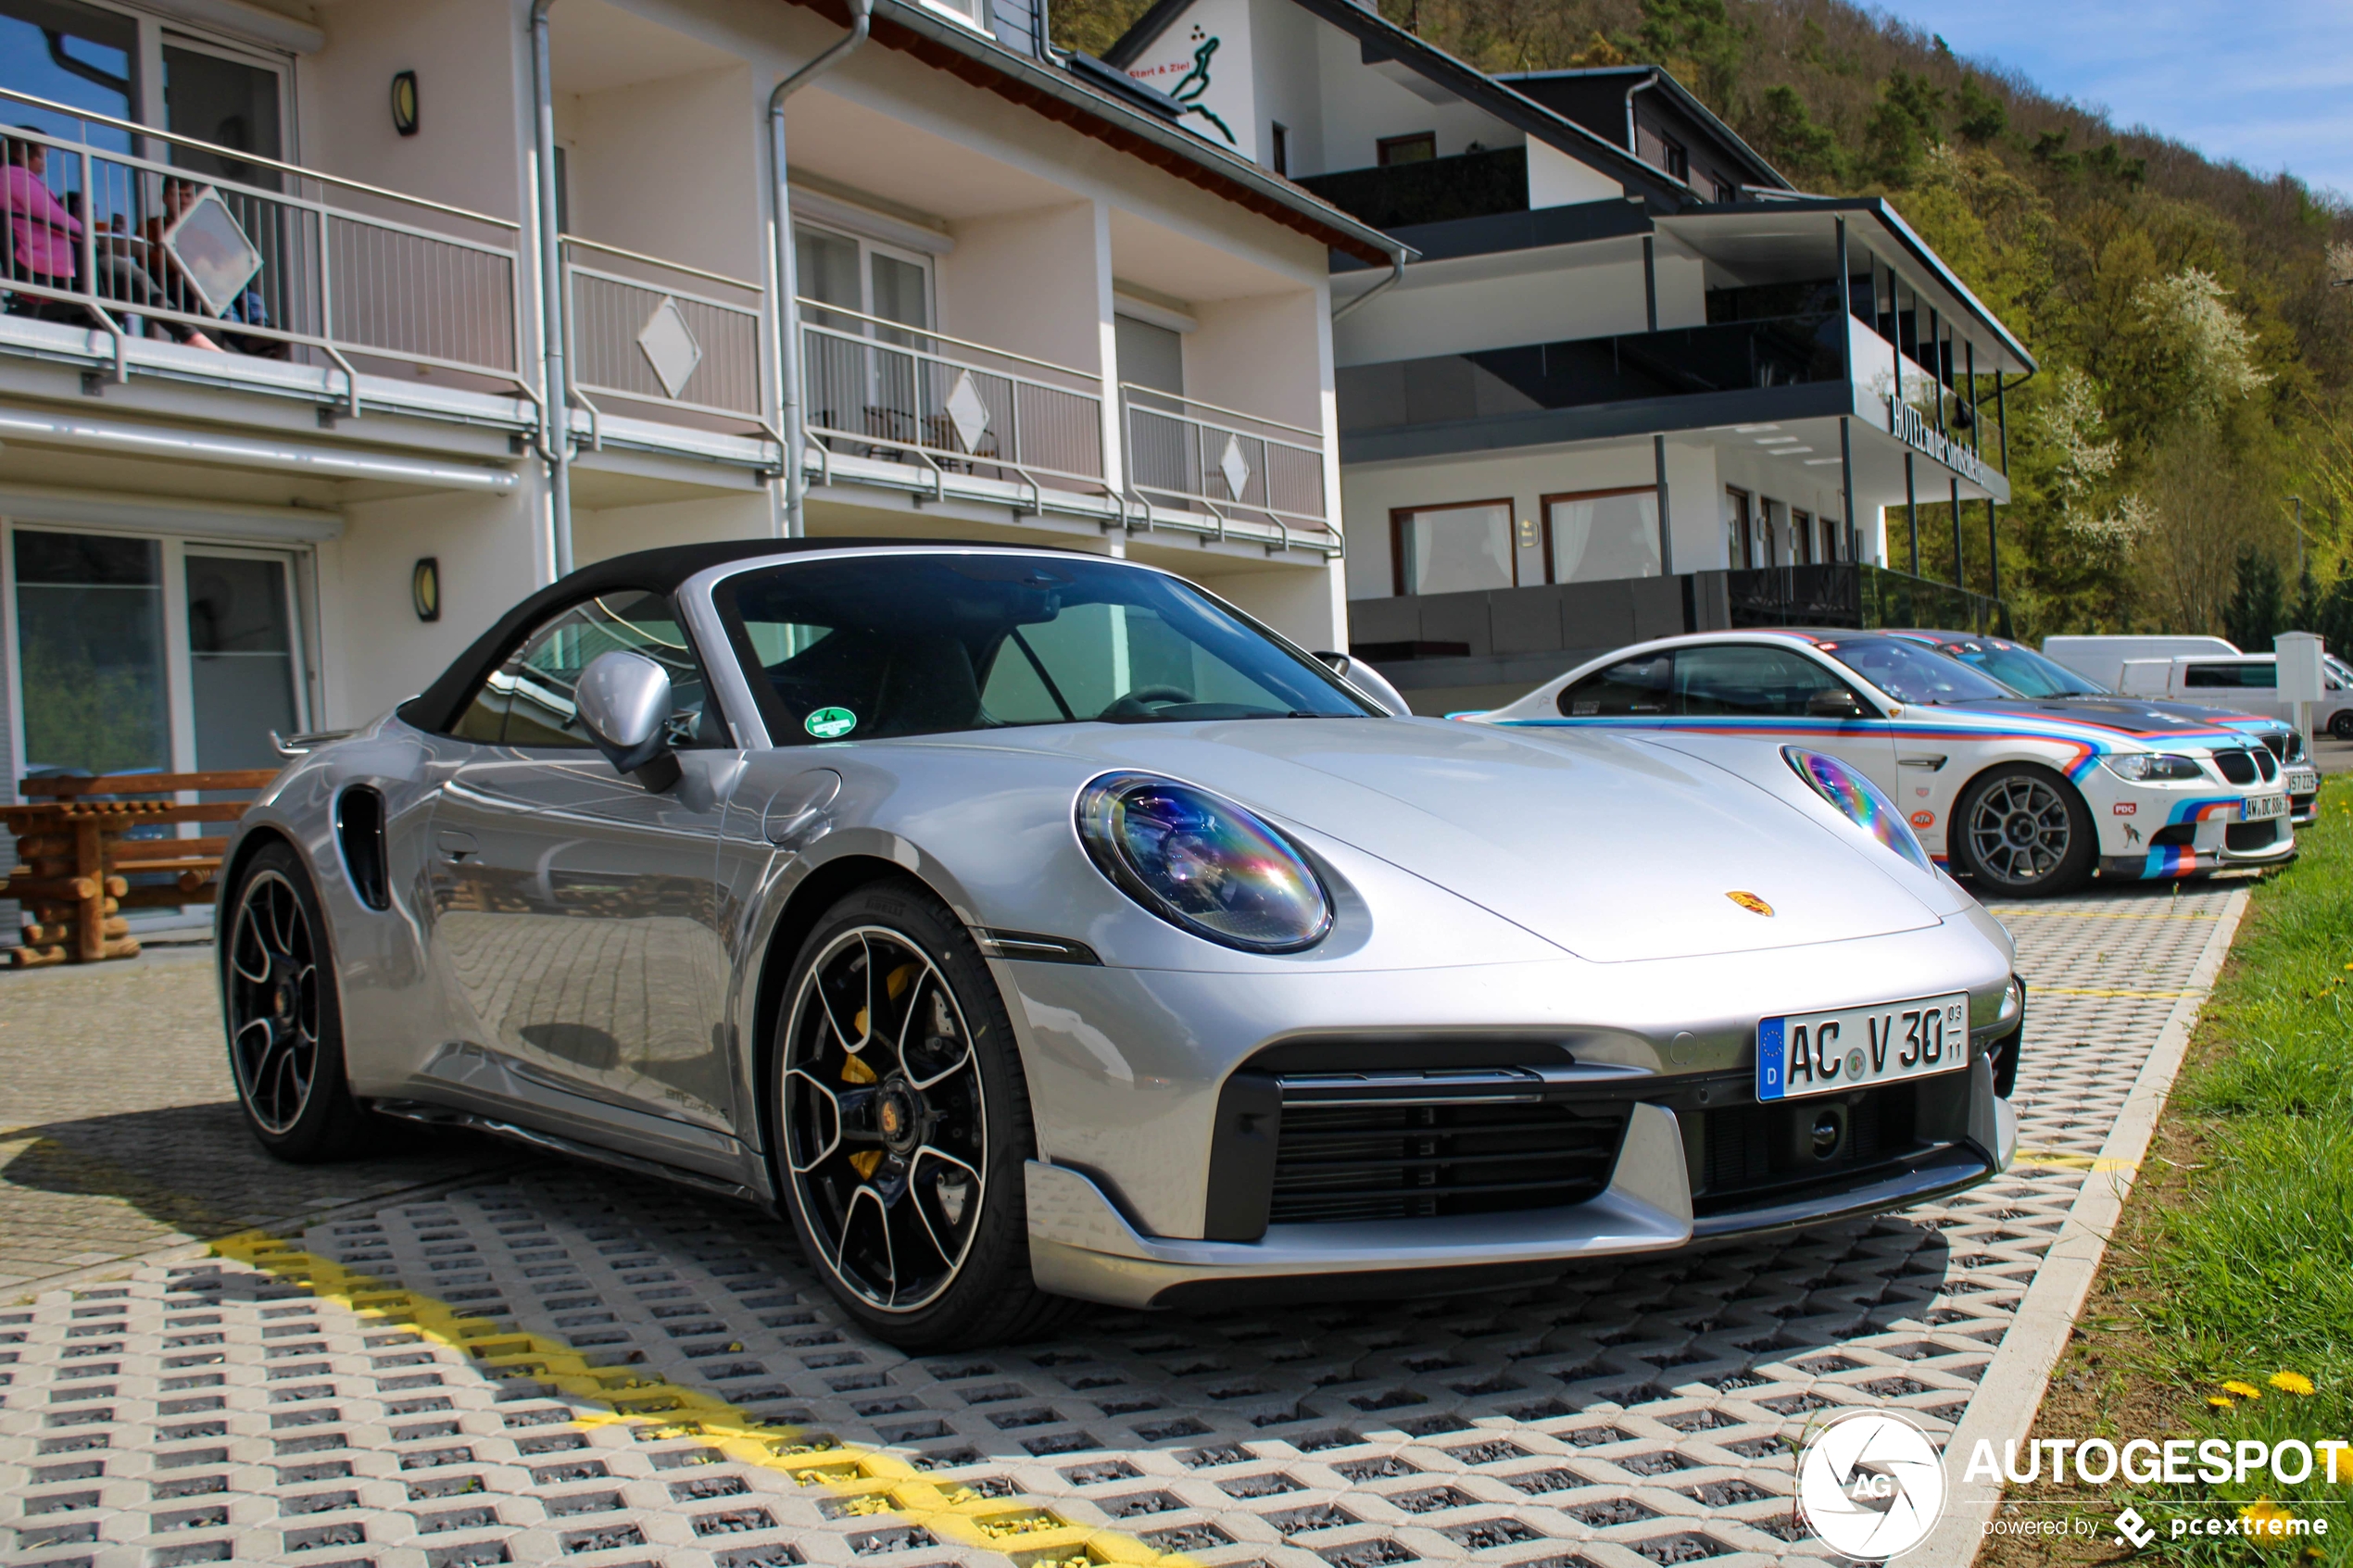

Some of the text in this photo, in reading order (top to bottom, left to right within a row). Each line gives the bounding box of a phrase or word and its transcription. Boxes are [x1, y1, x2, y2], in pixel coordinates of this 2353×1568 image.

[1129, 61, 1190, 79] Start & Ziel
[1893, 394, 1926, 453] HOTEL
[824, 709, 837, 721] 4
[865, 895, 906, 917] PIRELLI
[1948, 1002, 1962, 1021] 03
[1788, 1007, 1942, 1085] AC V 30
[1948, 1040, 1961, 1060] 11
[1767, 1068, 1777, 1085] D
